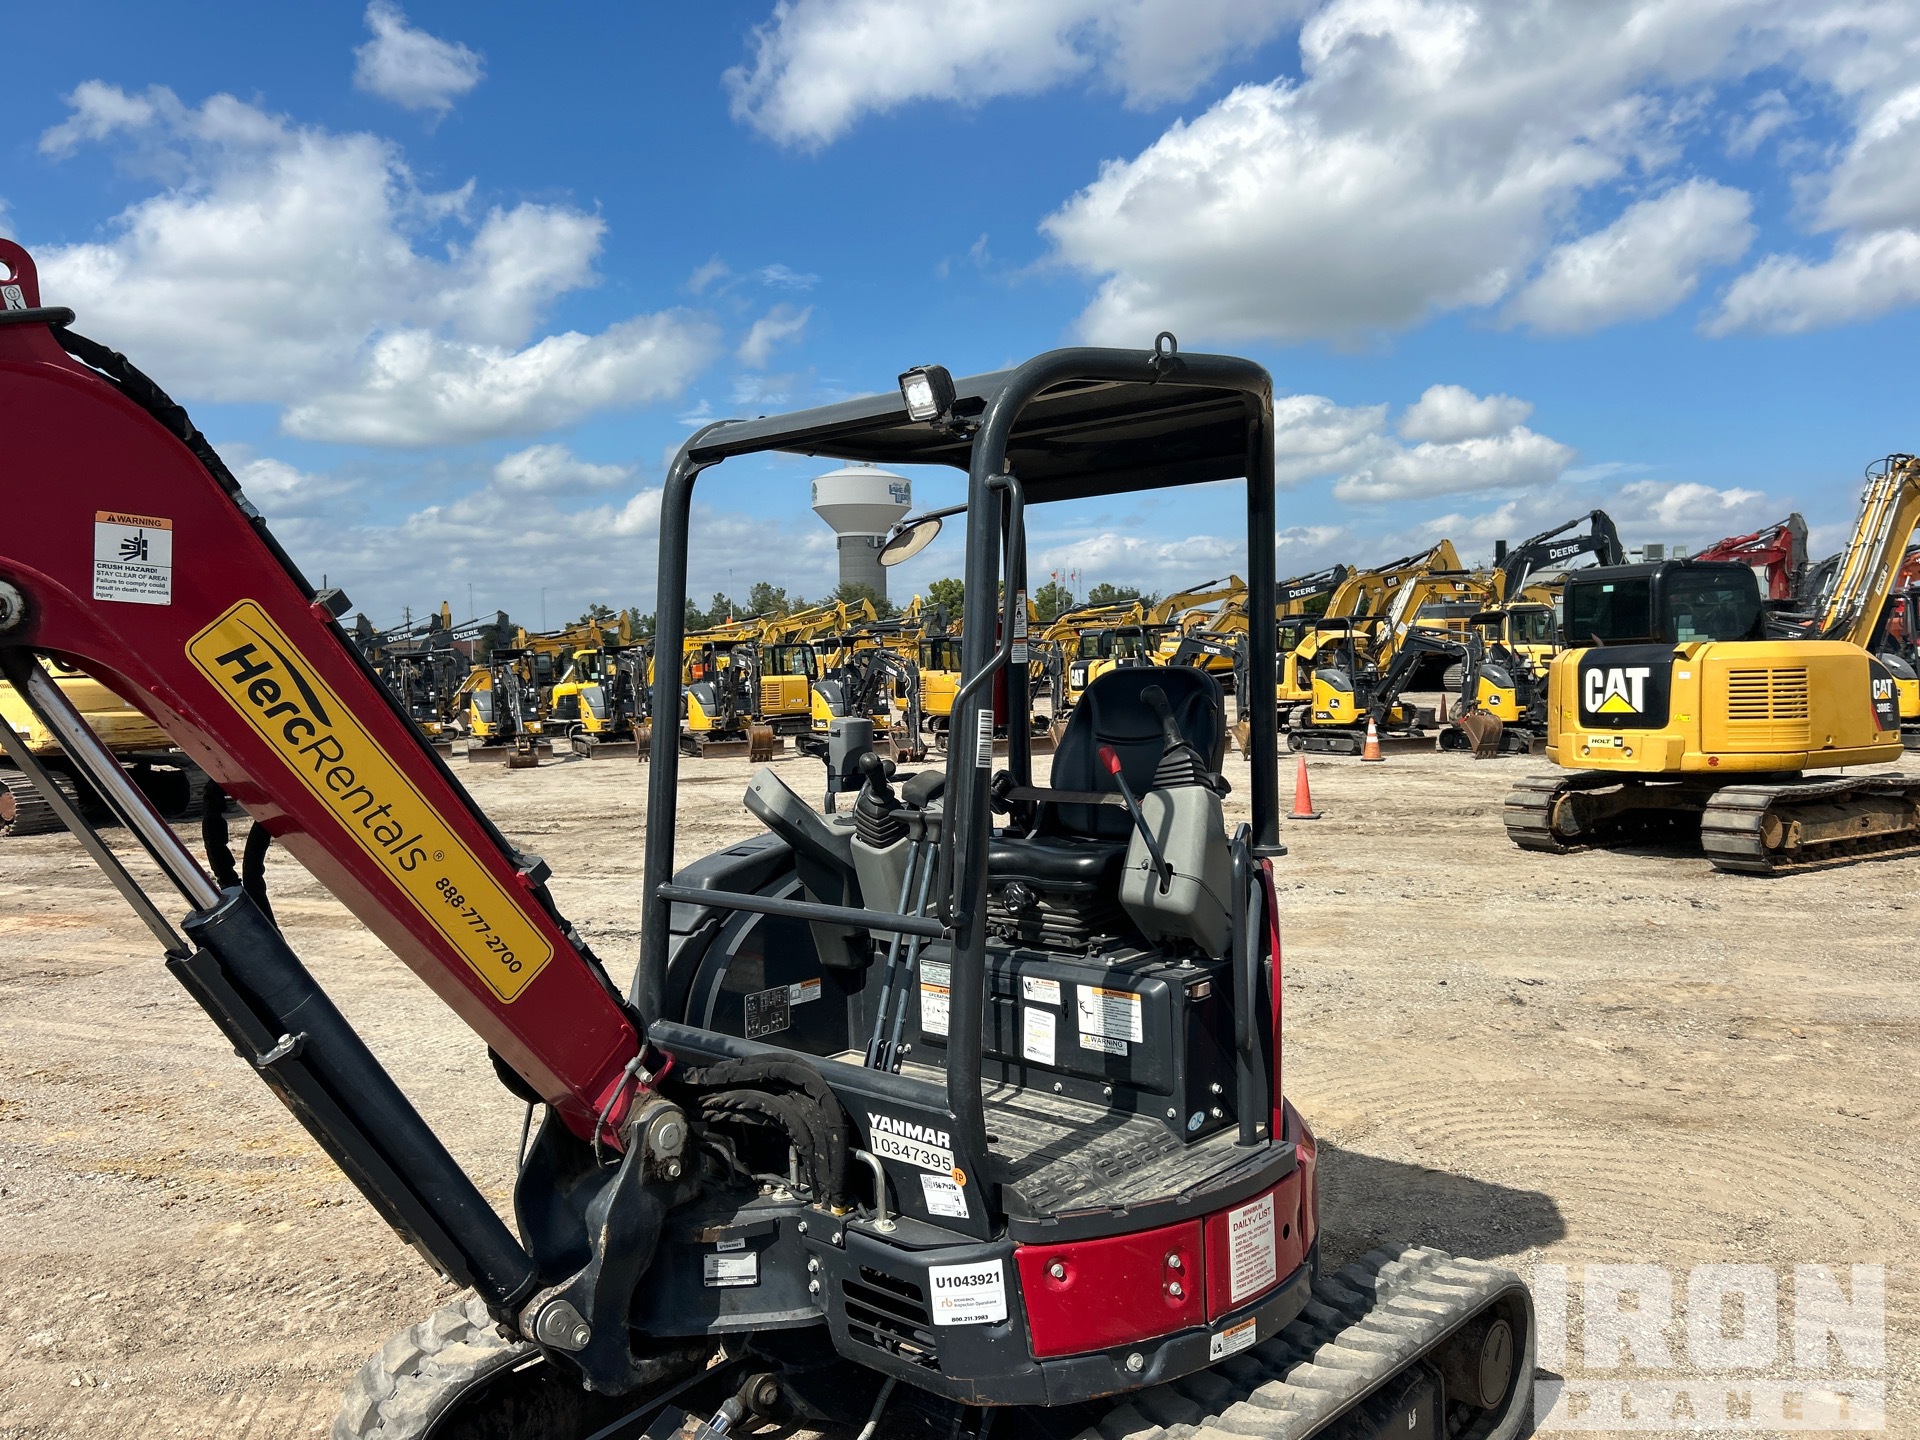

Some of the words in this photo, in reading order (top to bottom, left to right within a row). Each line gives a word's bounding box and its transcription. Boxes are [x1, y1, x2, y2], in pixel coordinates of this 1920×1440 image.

[116, 515, 162, 527] WARNING
[1549, 544, 1580, 560] DEERE
[124, 566, 158, 574] HAZARD!
[1387, 576, 1398, 587] CAT
[1288, 586, 1316, 598] DEERE
[387, 632, 413, 642] DEERE
[452, 628, 479, 640] DEERE
[1204, 645, 1220, 654] DEERE
[886, 665, 898, 676] DEERE
[1072, 669, 1084, 686] CAT
[1586, 668, 1650, 713] CAT
[1873, 679, 1892, 699] CAT
[436, 877, 522, 974] 888-777-2700
[1090, 1037, 1122, 1047] WARNING
[868, 1112, 950, 1148] YANMAR
[872, 1136, 952, 1171] 10347395
[1243, 1202, 1262, 1217] MINIMUM
[1233, 1216, 1251, 1232] DAILY
[1259, 1207, 1270, 1219] LIST
[936, 1271, 1000, 1288] U1043921
